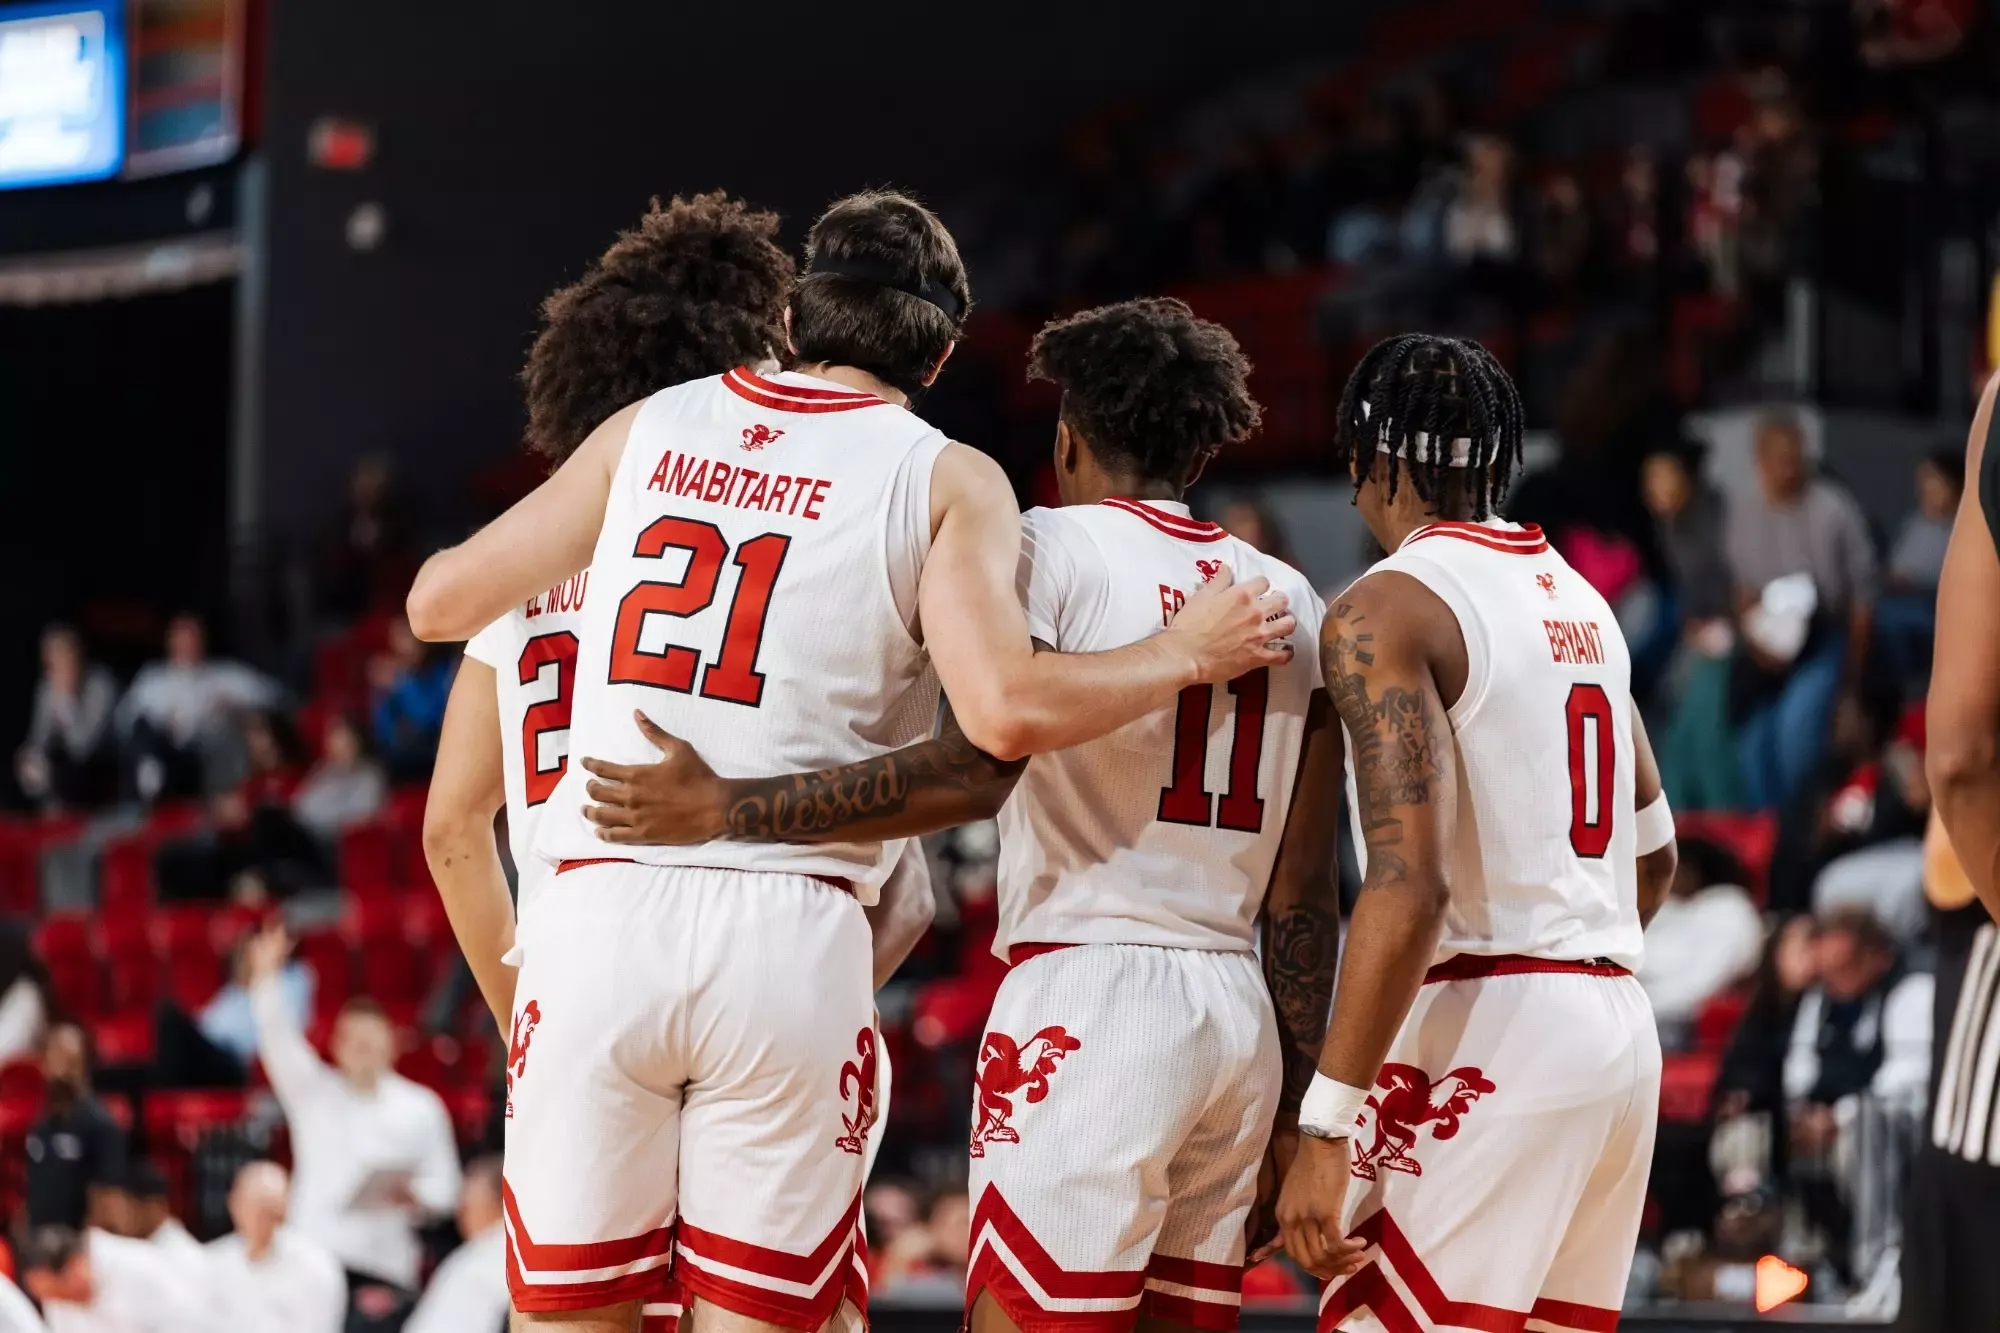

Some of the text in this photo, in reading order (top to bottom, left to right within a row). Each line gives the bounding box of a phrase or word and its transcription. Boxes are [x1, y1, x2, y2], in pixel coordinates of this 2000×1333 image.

[647, 450, 832, 520] ANABITARTE
[607, 514, 792, 708] 21
[1542, 619, 1605, 665] BRYANT
[726, 755, 909, 840] Blessed
[1157, 666, 1269, 834] 11
[1565, 683, 1615, 859] 0
